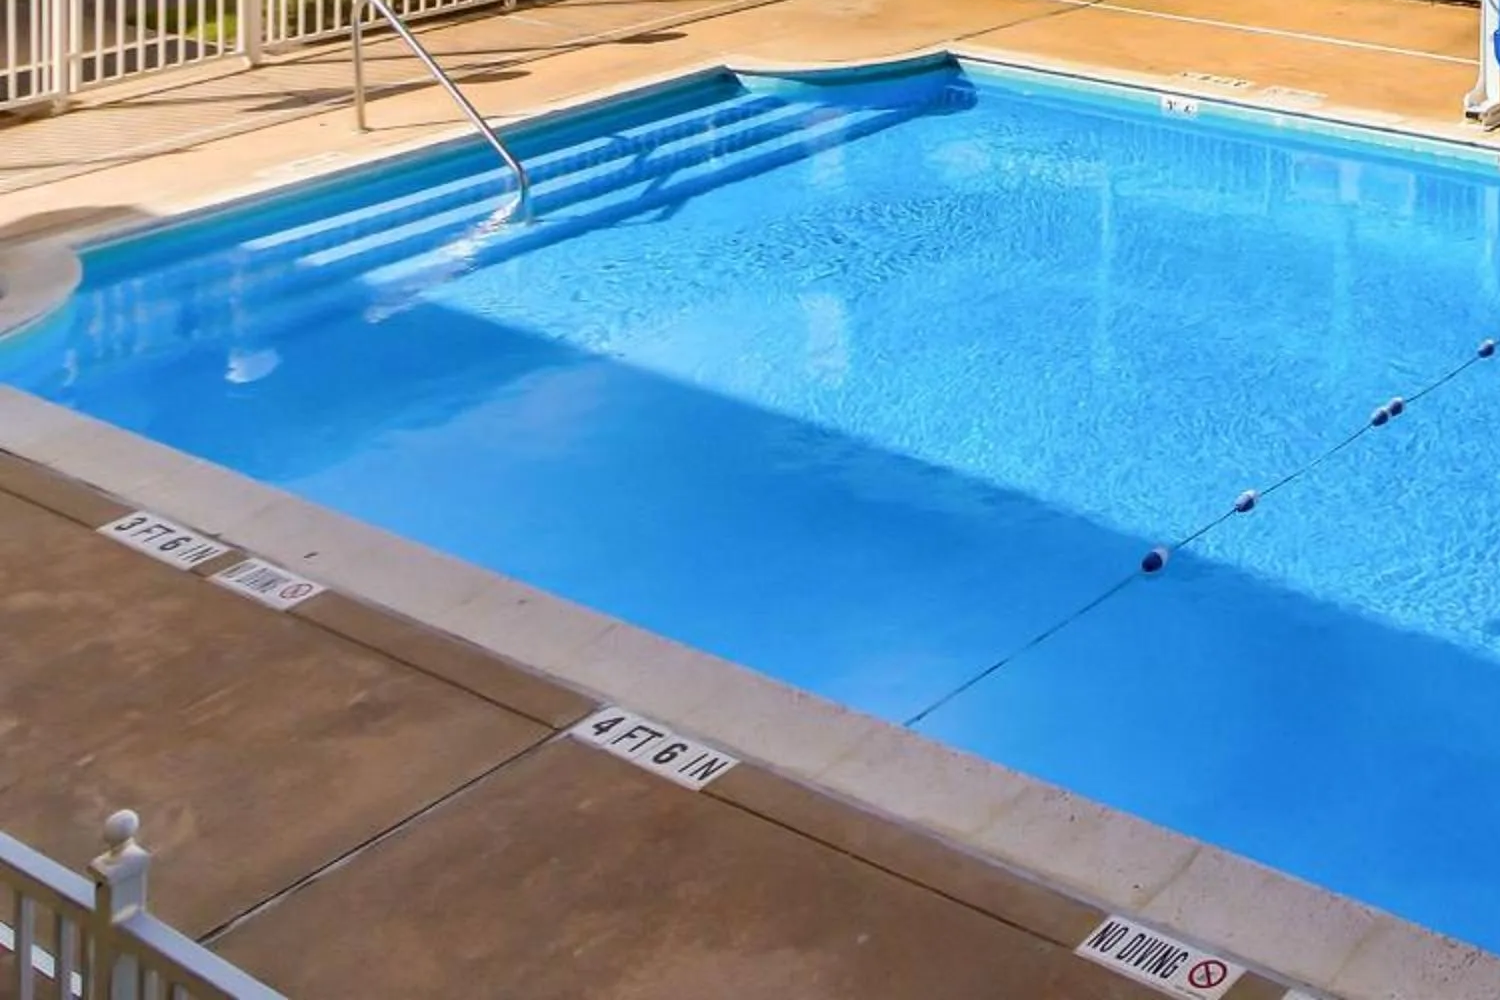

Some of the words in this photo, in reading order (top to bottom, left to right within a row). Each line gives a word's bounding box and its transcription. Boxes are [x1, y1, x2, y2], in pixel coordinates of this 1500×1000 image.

[114, 516, 147, 532] 3
[131, 523, 176, 543] FT
[159, 536, 193, 551] 6
[178, 543, 220, 563] IN
[592, 716, 625, 737] 4
[611, 725, 665, 753] FT
[652, 743, 688, 765] 6
[678, 753, 729, 781] IN
[1087, 921, 1129, 950] NO
[1116, 933, 1189, 979] DIVING
